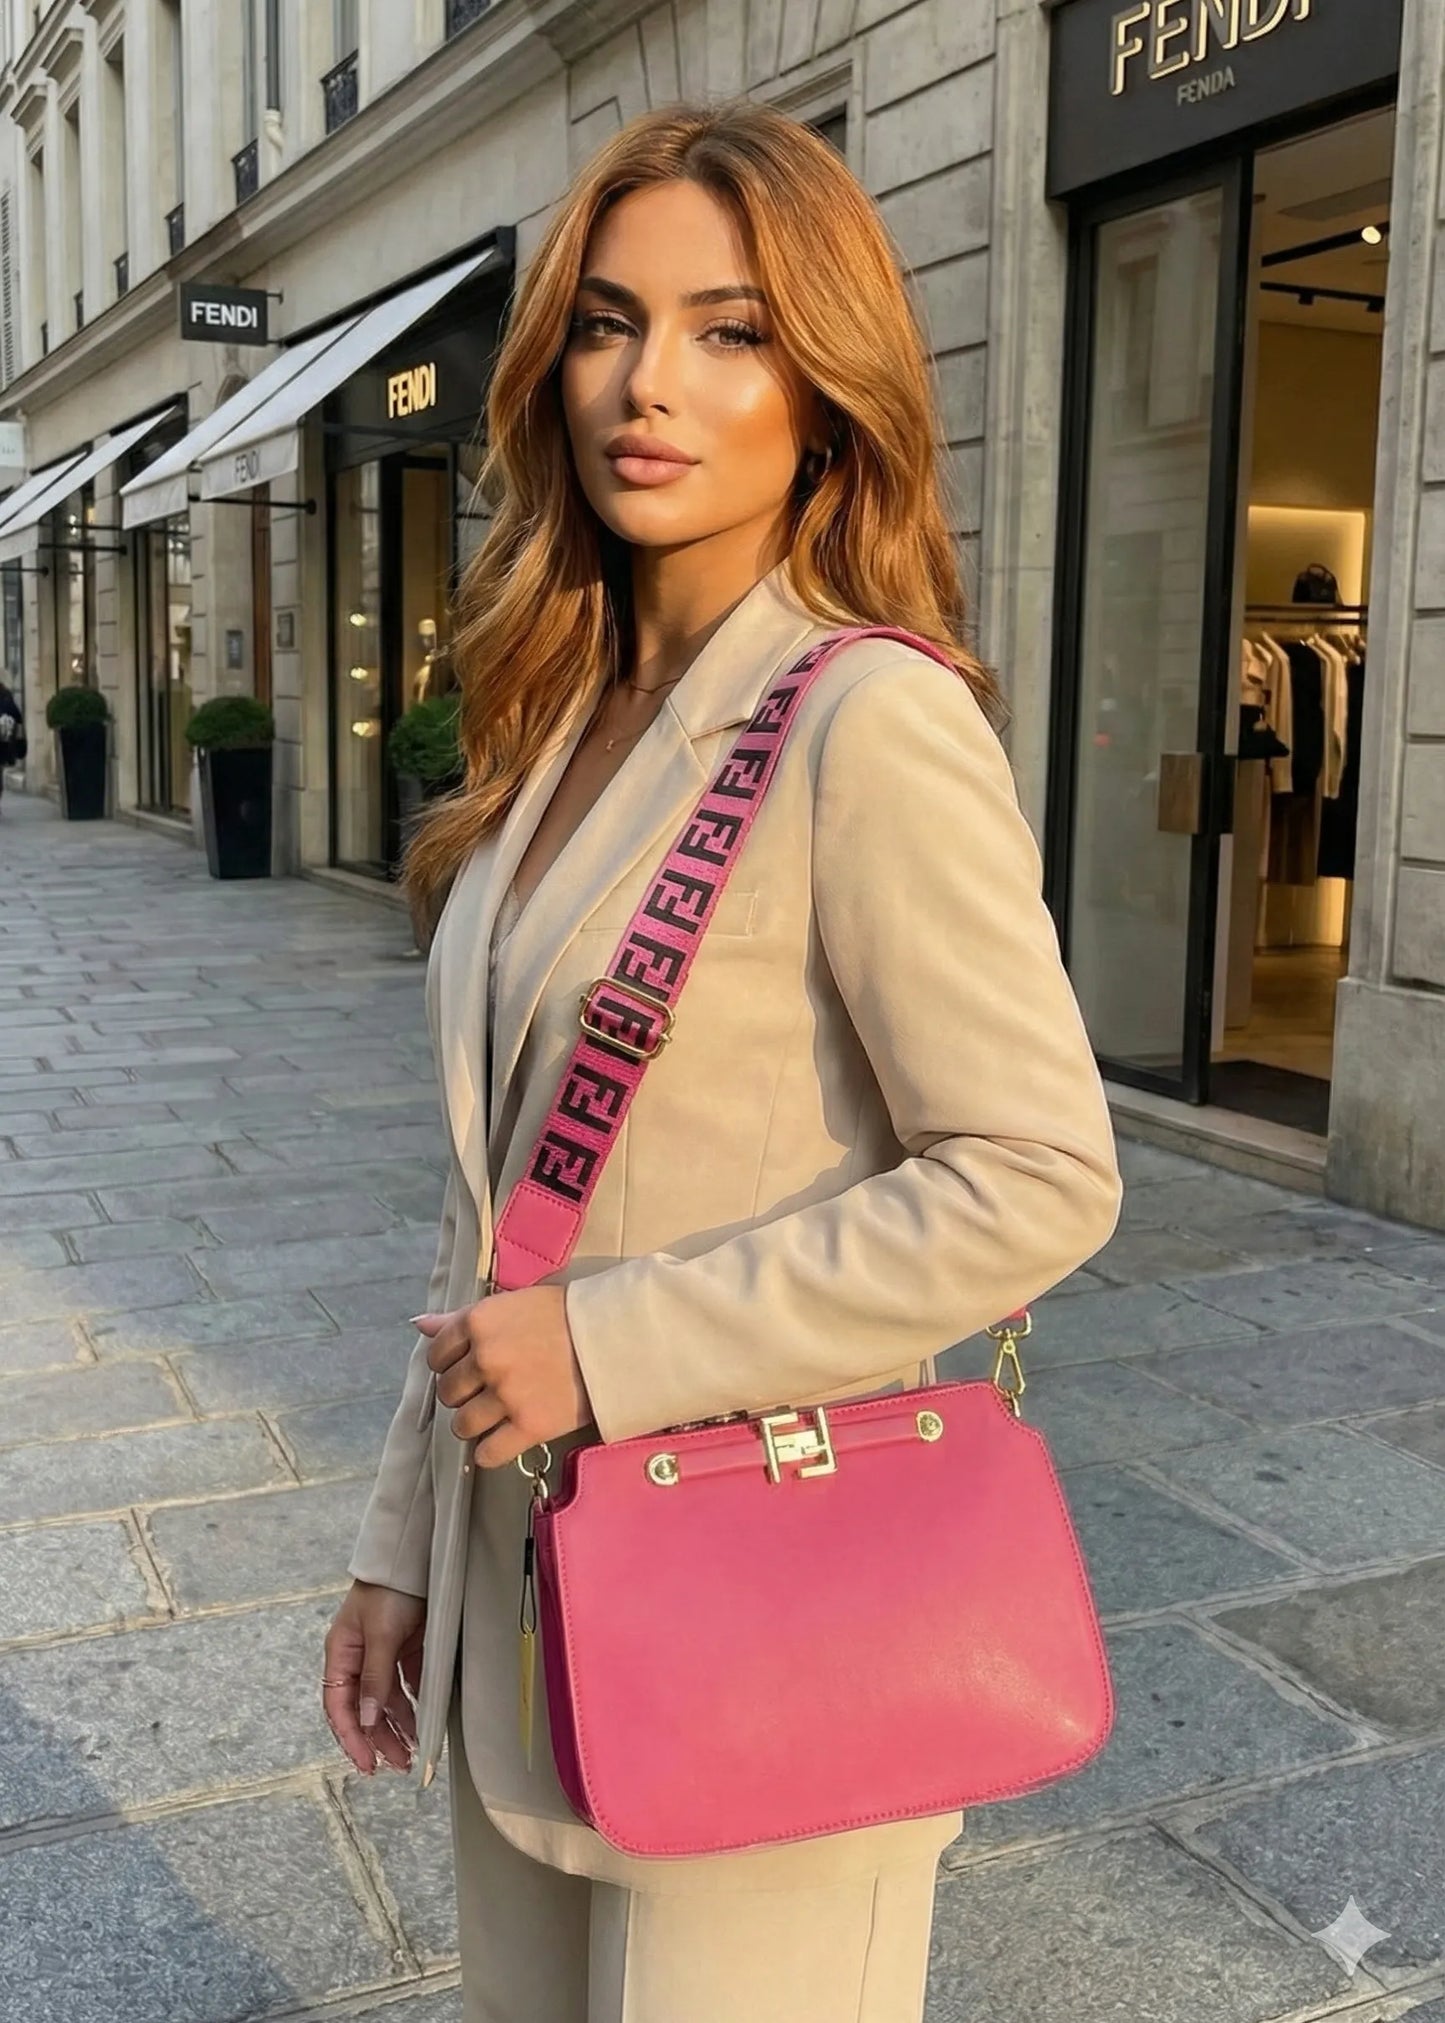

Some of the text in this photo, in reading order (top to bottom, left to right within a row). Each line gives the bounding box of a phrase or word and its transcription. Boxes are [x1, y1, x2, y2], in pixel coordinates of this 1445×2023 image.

[1109, 0, 1309, 95] FEN
[1177, 65, 1235, 106] FENDA
[190, 301, 258, 328] FENDI
[388, 362, 437, 419] FENDI
